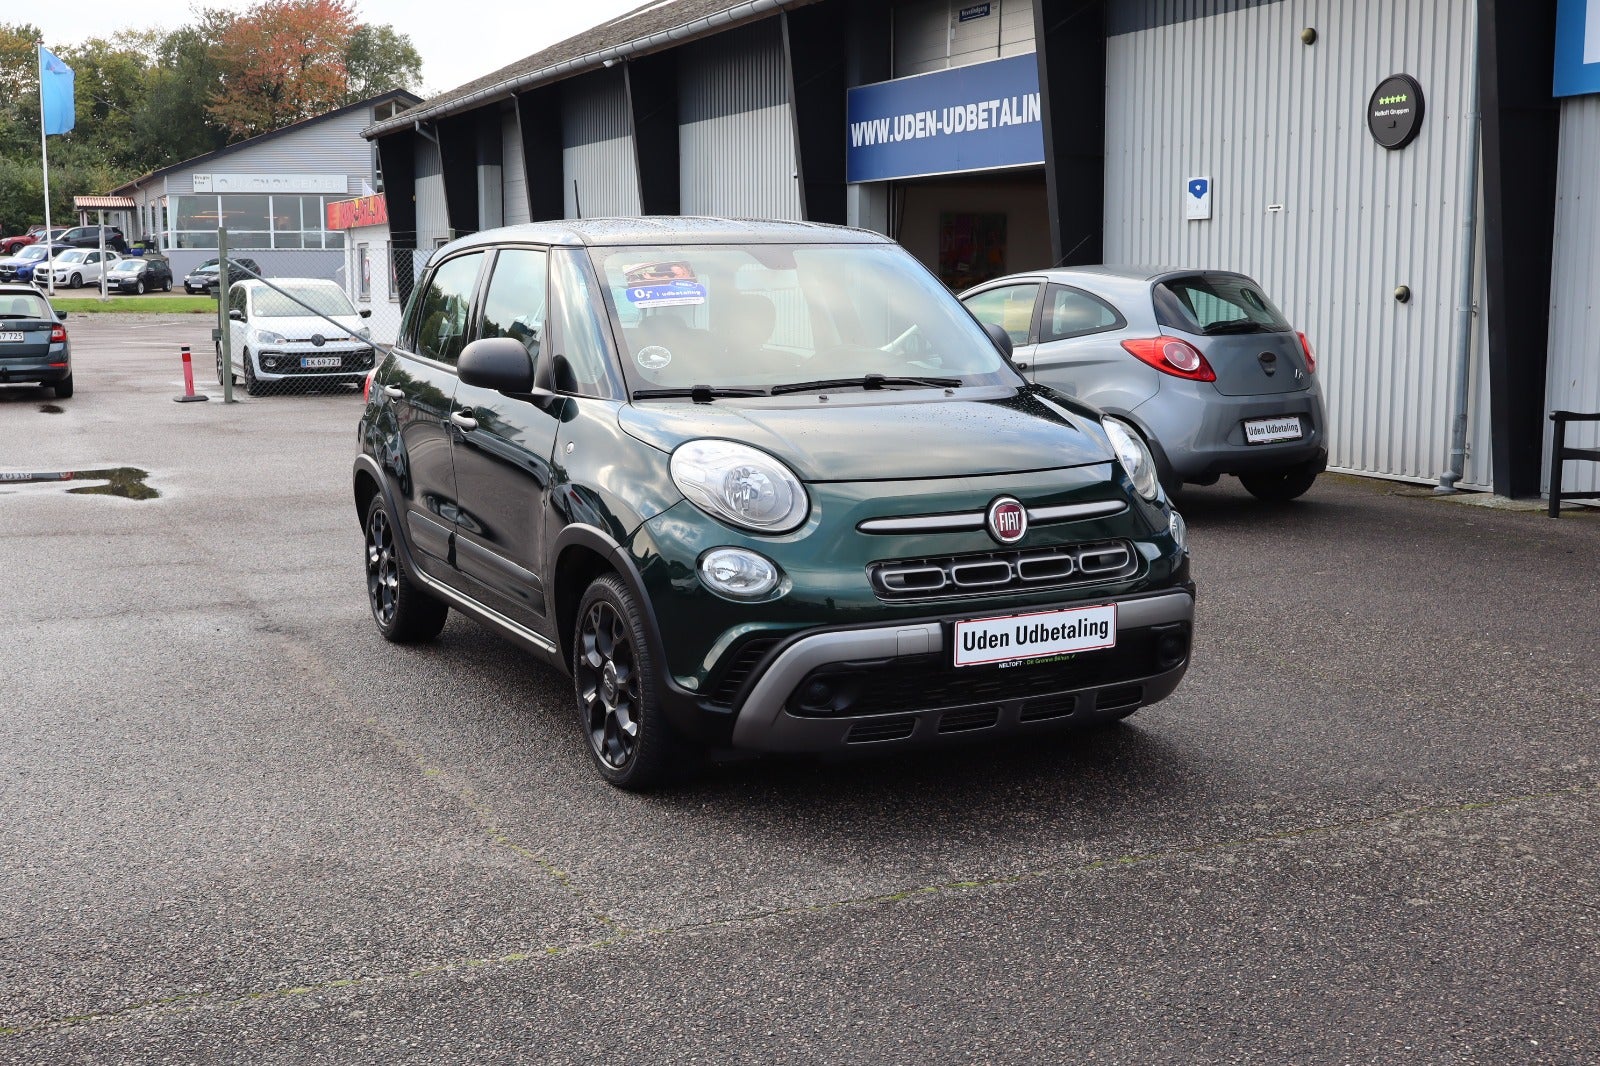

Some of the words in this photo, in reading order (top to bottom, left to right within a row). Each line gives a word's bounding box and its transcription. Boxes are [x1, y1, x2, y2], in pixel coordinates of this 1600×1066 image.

[851, 92, 1041, 148] WWW.UDEN-UDBETALIN
[9, 332, 23, 340] 725
[328, 358, 340, 366] 727
[1248, 427, 1265, 436] Uden
[1265, 423, 1299, 434] Udbetaling
[998, 511, 1020, 532] FIAT
[963, 629, 1010, 652] Uden
[1015, 618, 1109, 646] Udbetaling
[998, 660, 1023, 669] NELTOFT
